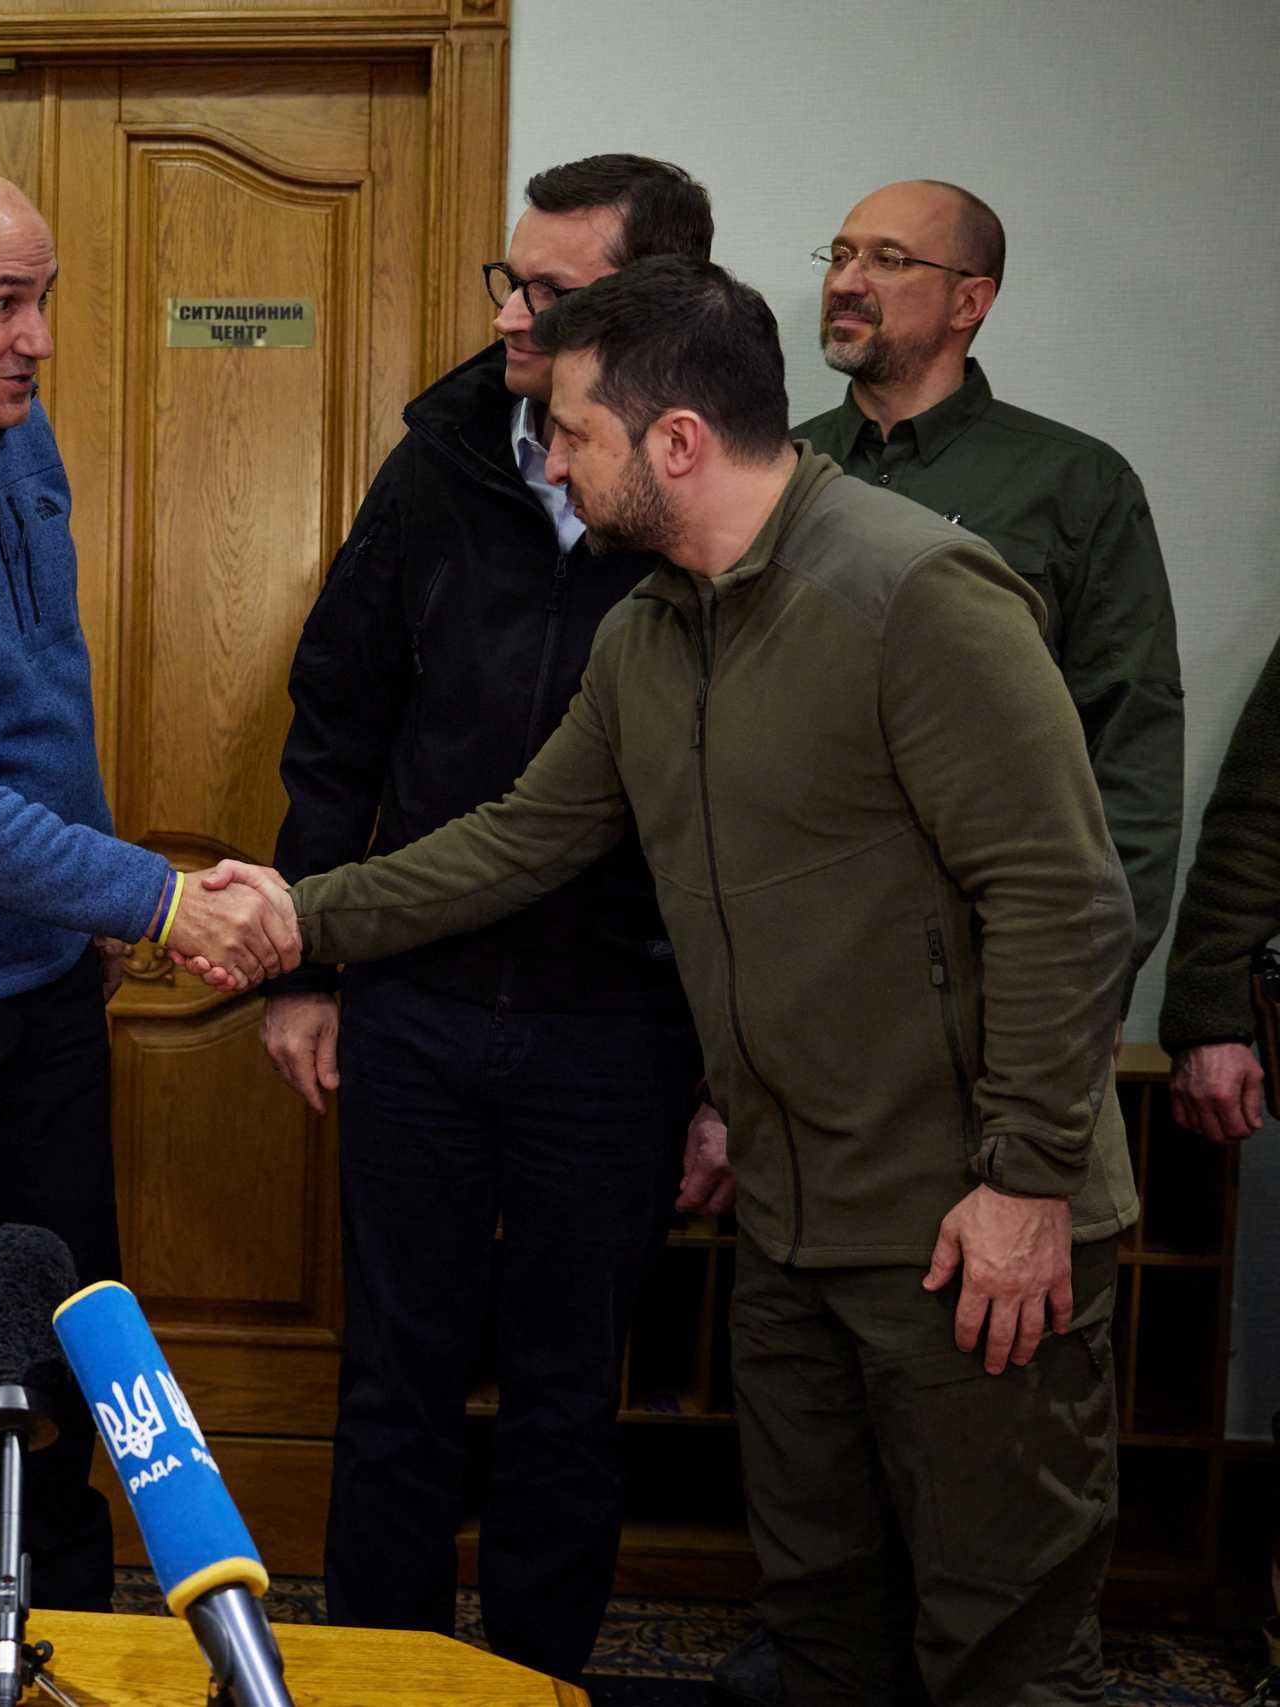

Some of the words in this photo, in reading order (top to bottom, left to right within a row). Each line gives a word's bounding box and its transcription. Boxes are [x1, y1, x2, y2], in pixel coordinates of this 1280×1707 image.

[179, 303, 304, 322] СИТУАЦІЙНИЙ
[210, 325, 268, 341] ЦЕНТР
[129, 1454, 183, 1495] РАДА
